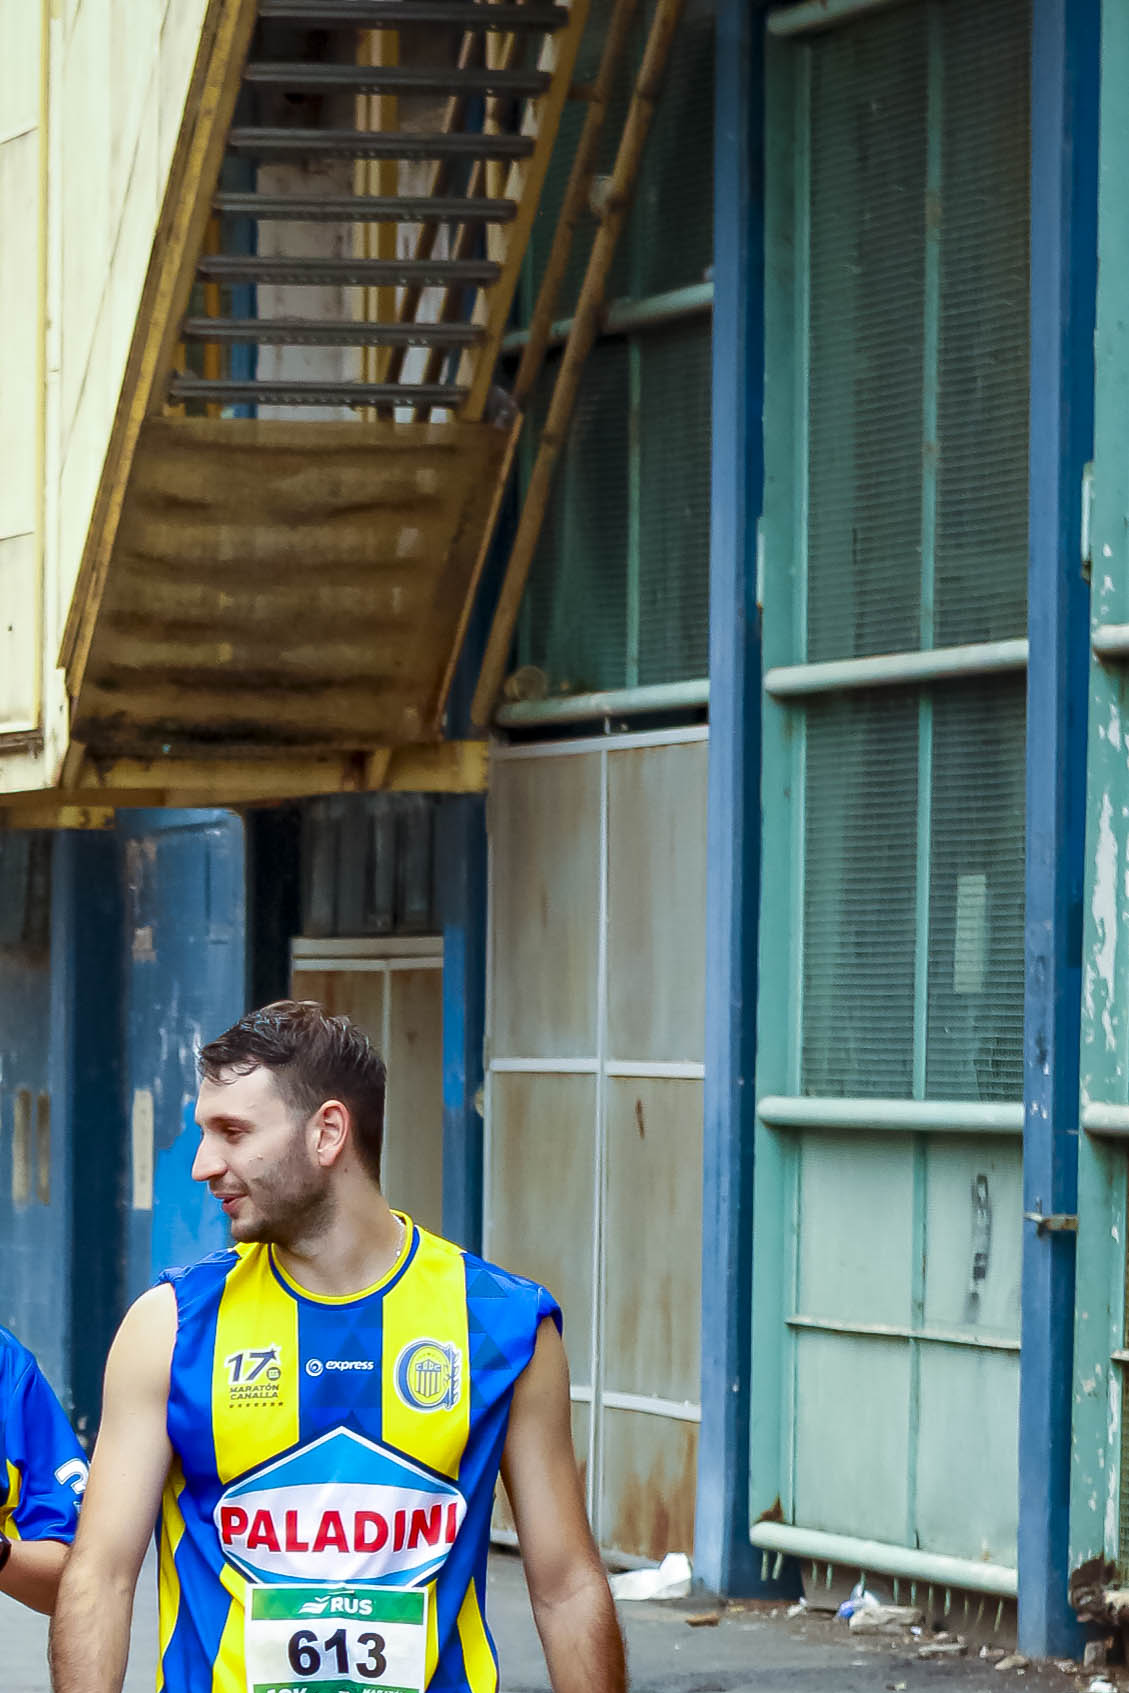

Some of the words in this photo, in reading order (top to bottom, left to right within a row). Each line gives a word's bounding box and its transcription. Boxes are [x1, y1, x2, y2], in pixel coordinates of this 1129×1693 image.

[325, 1359, 374, 1371] express
[229, 1383, 280, 1393] MARATÓN
[230, 1391, 279, 1400] CANALLA
[220, 1502, 458, 1553] PALADINI
[329, 1596, 374, 1616] RUS
[287, 1628, 388, 1679] 613
